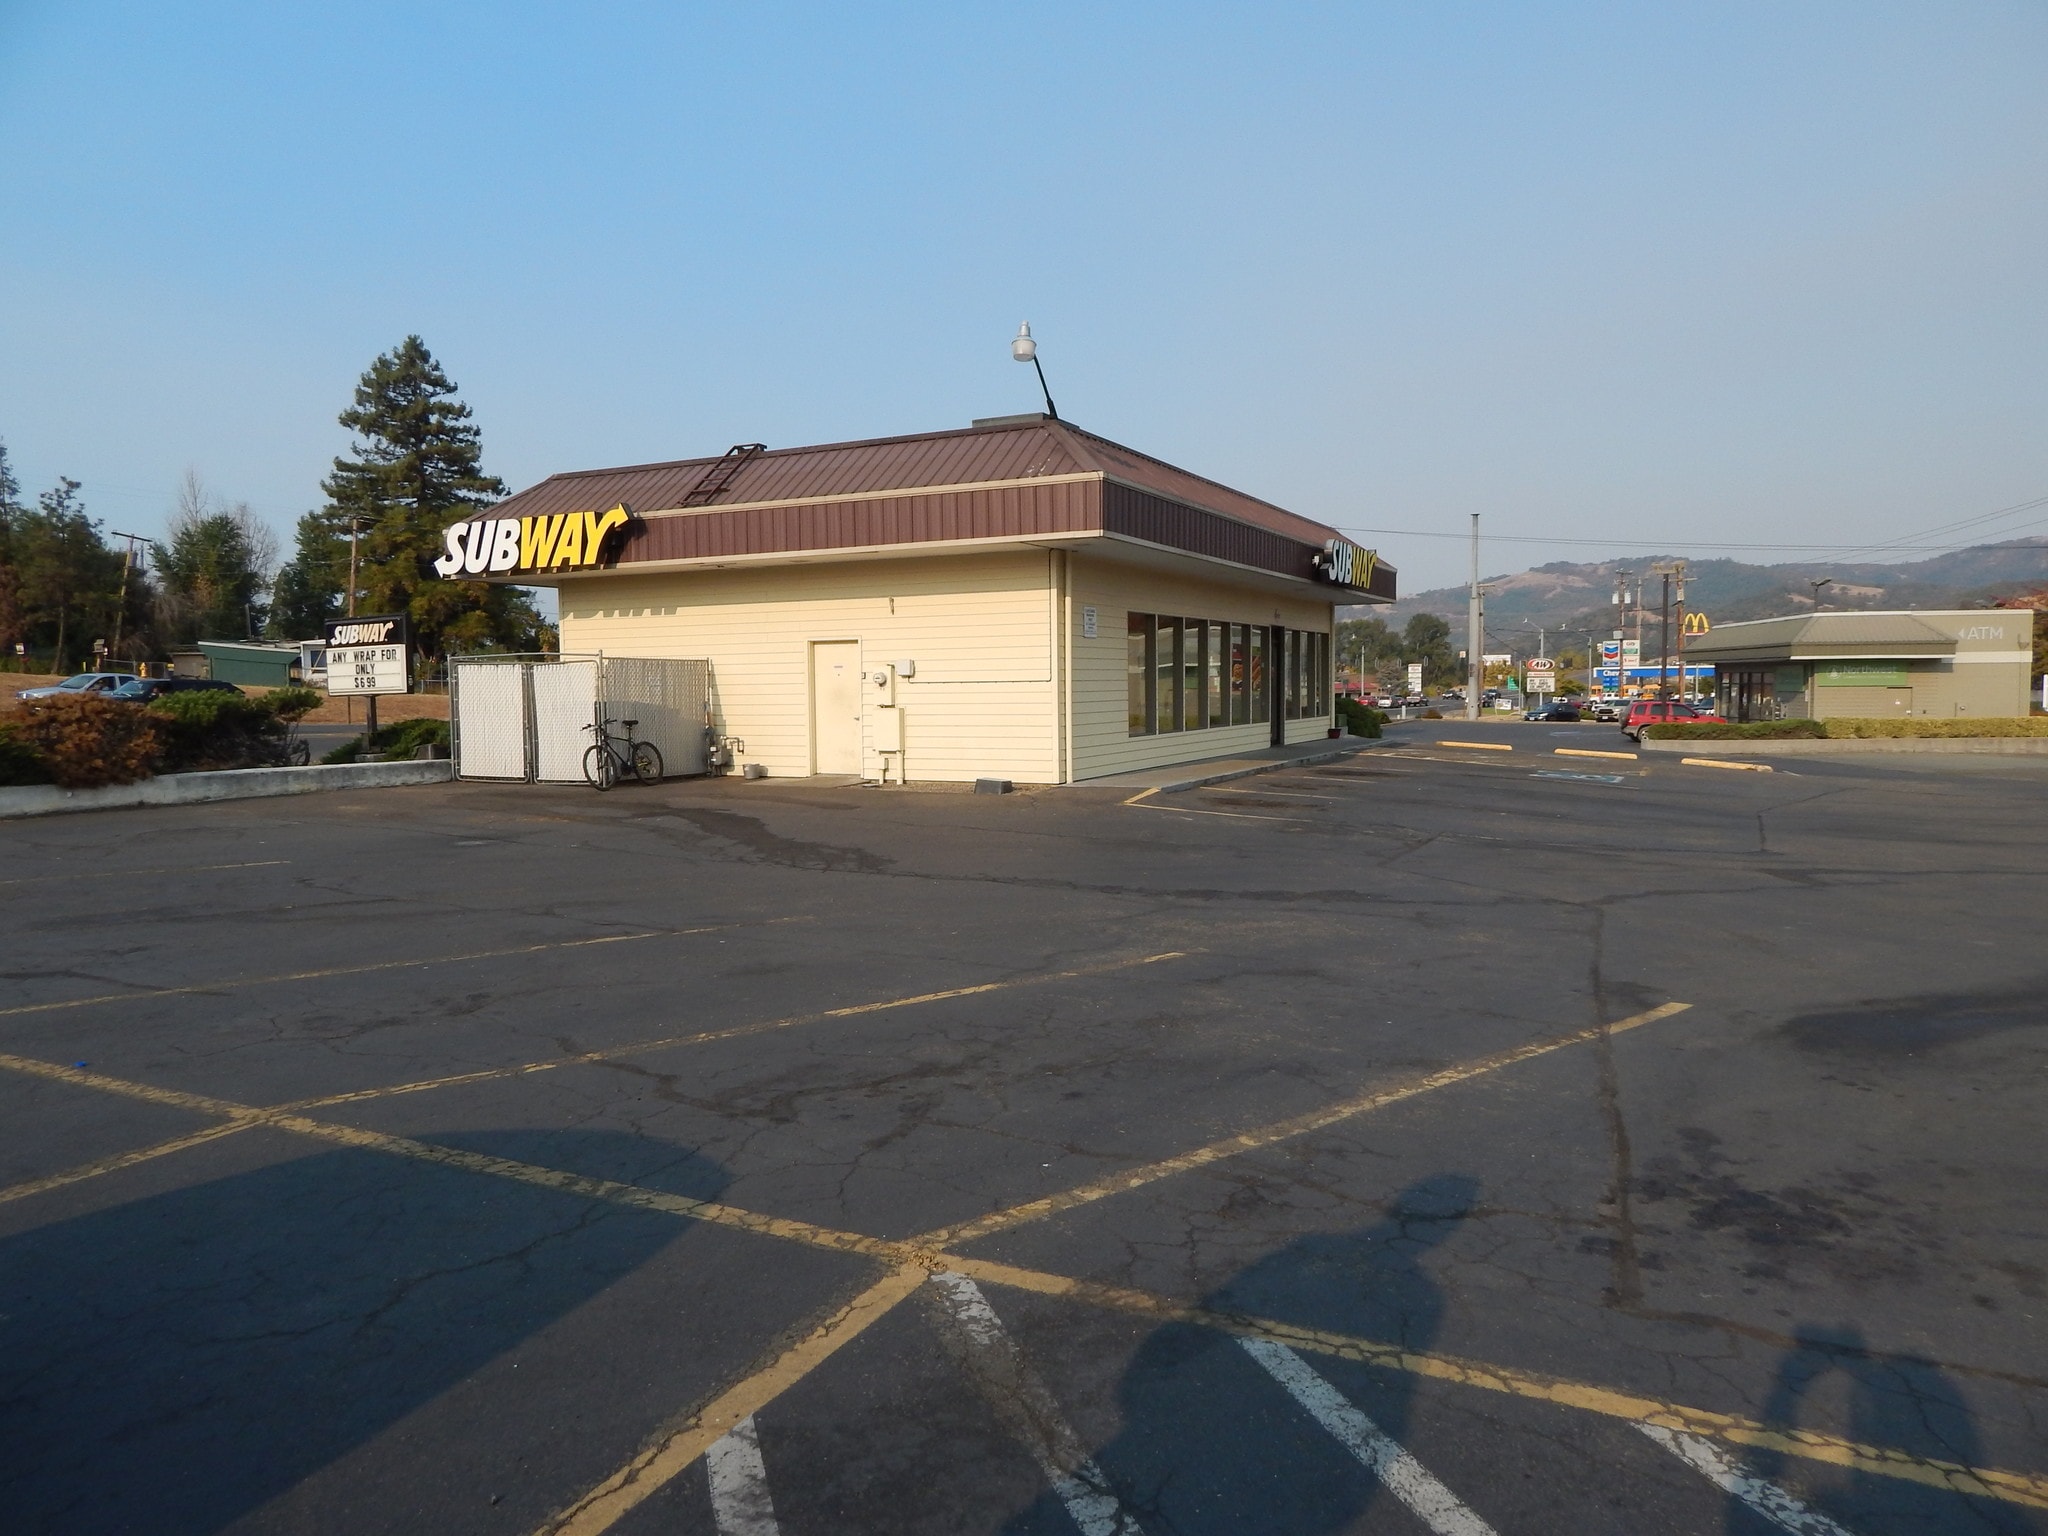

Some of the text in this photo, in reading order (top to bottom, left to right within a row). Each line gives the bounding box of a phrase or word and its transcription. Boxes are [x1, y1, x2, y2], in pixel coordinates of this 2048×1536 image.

[433, 503, 630, 579] SUBWAY
[1328, 539, 1378, 590] SUBWAY
[330, 621, 394, 646] SUBWAY
[1967, 626, 2004, 640] ATM
[332, 649, 397, 663] ANY WRAP FOR
[355, 663, 376, 675] ONLY
[1843, 664, 1898, 674] Northwest
